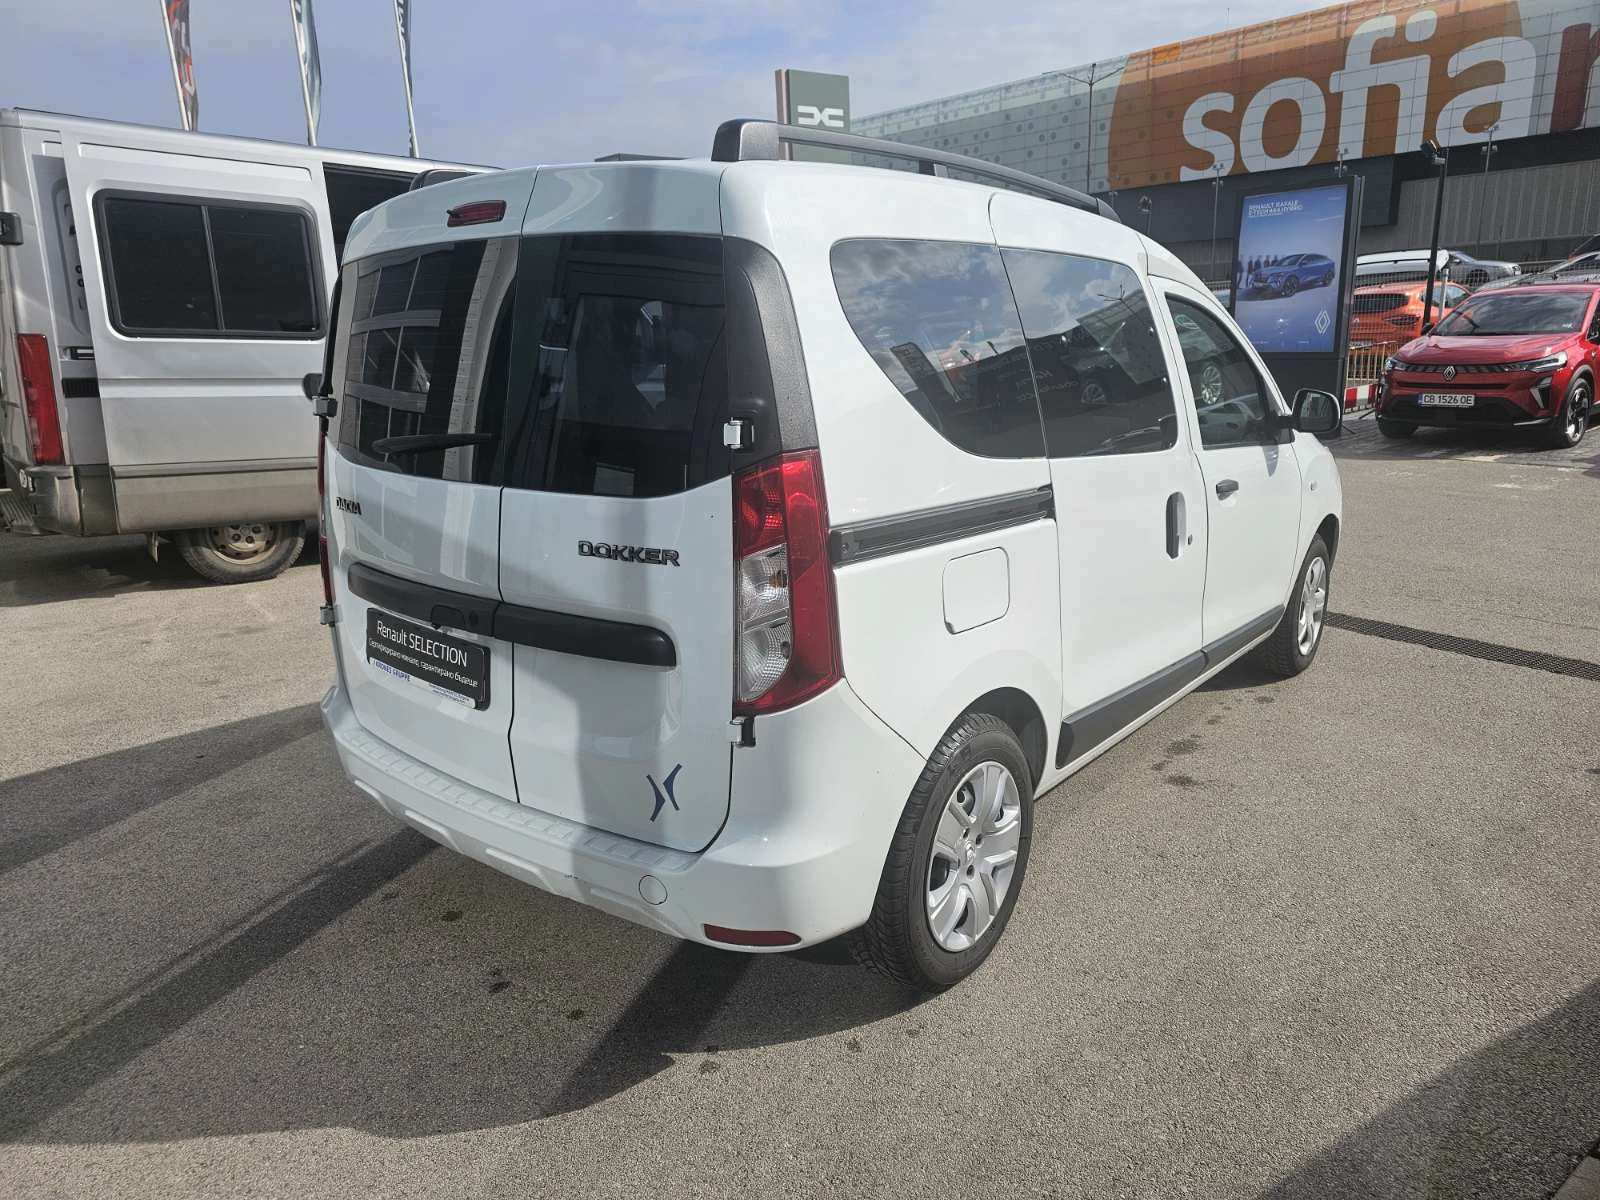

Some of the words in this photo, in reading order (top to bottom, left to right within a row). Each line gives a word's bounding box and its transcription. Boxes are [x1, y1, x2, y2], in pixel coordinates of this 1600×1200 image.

[1180, 11, 1536, 183] sofia
[1424, 395, 1435, 403] CB
[1438, 395, 1459, 404] 1526
[578, 540, 680, 567] DOKKER
[377, 620, 408, 646] Renault
[408, 633, 468, 668] SELECTION
